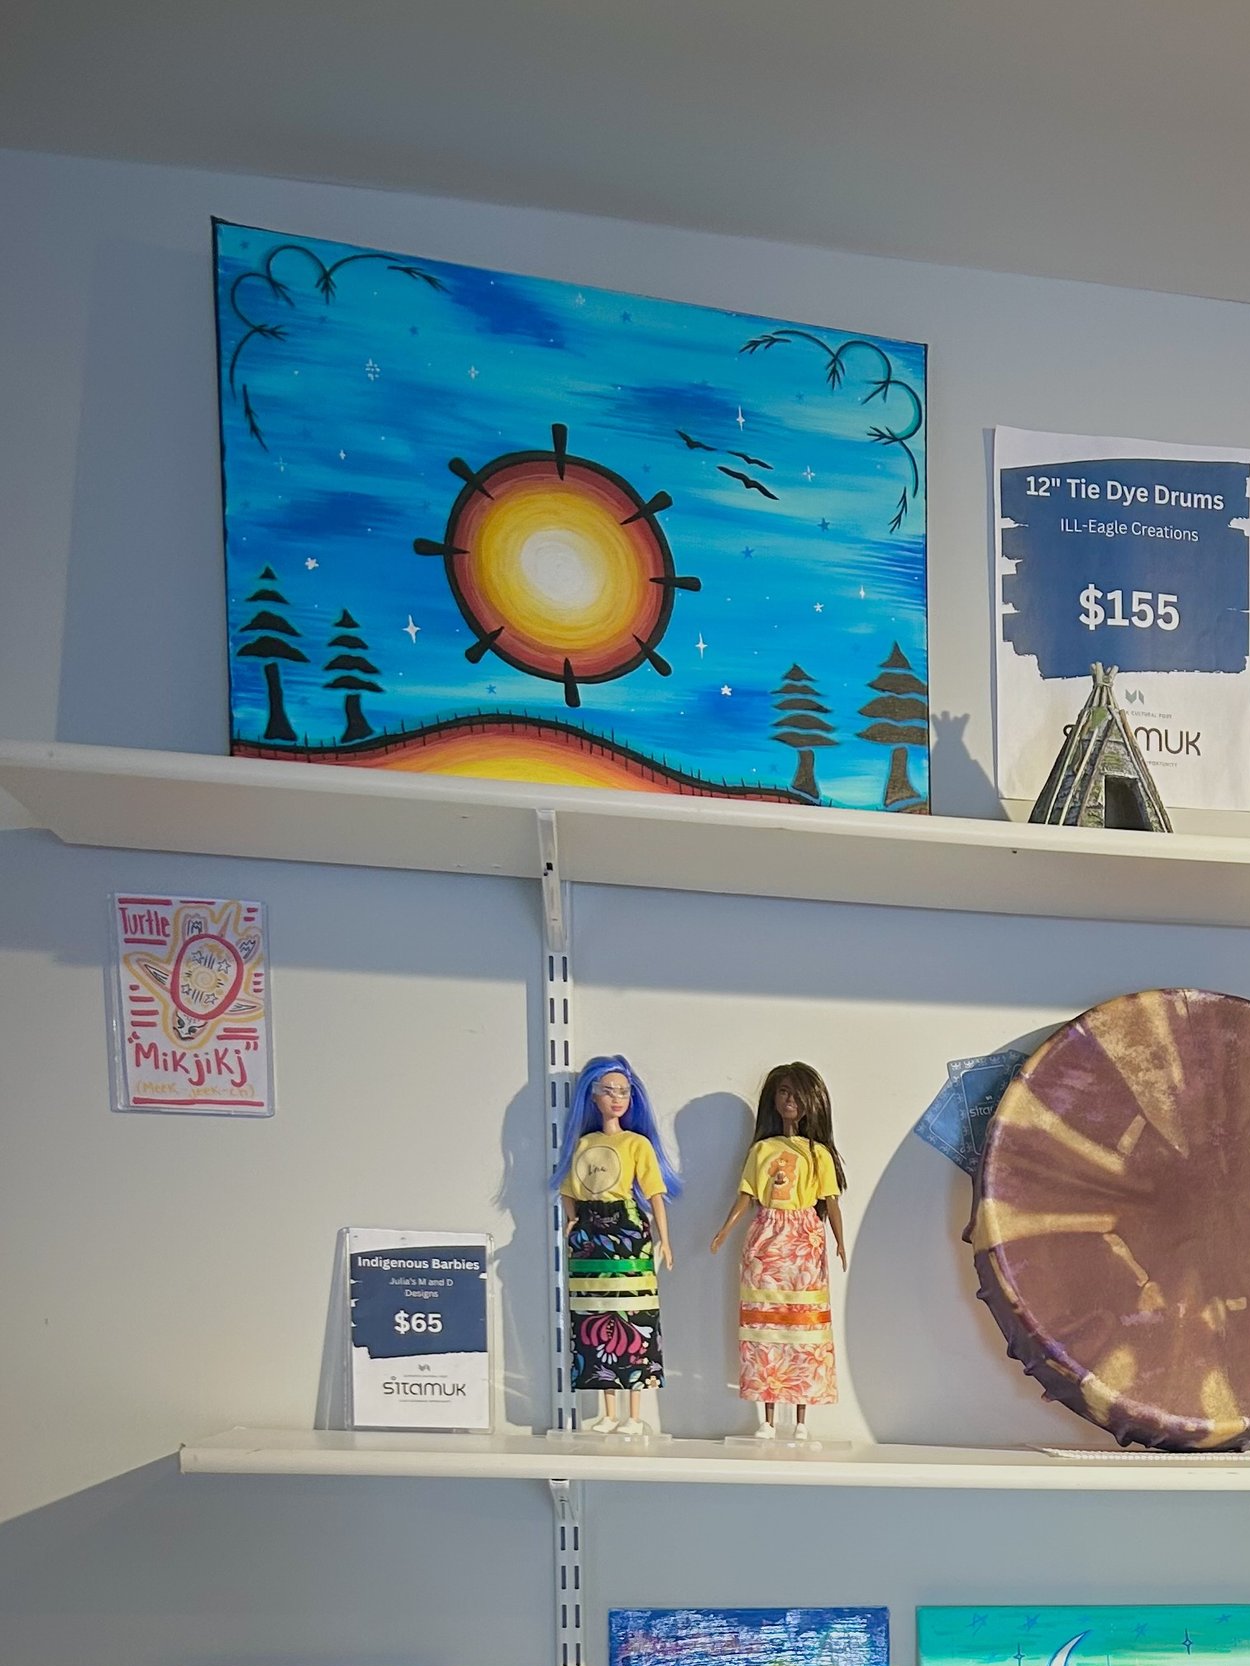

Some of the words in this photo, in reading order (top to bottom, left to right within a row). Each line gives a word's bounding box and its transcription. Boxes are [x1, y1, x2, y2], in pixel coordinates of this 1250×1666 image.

[1026, 475, 1060, 497] 12"
[1067, 478, 1100, 500] Tie
[1106, 480, 1149, 507] Dye
[1154, 485, 1225, 511] Drums
[1060, 518, 1128, 537] ILL-Eagle
[1131, 522, 1199, 542] Creations
[1078, 583, 1180, 631] $155
[119, 907, 171, 938] Turtle
[357, 1256, 429, 1270] Indigenous
[431, 1259, 480, 1270] Barbies
[389, 1277, 417, 1286] Julia's
[418, 1278, 427, 1286] M
[428, 1278, 444, 1287] and
[446, 1279, 454, 1287] D
[405, 1289, 439, 1299] Designs
[394, 1310, 443, 1335] $65
